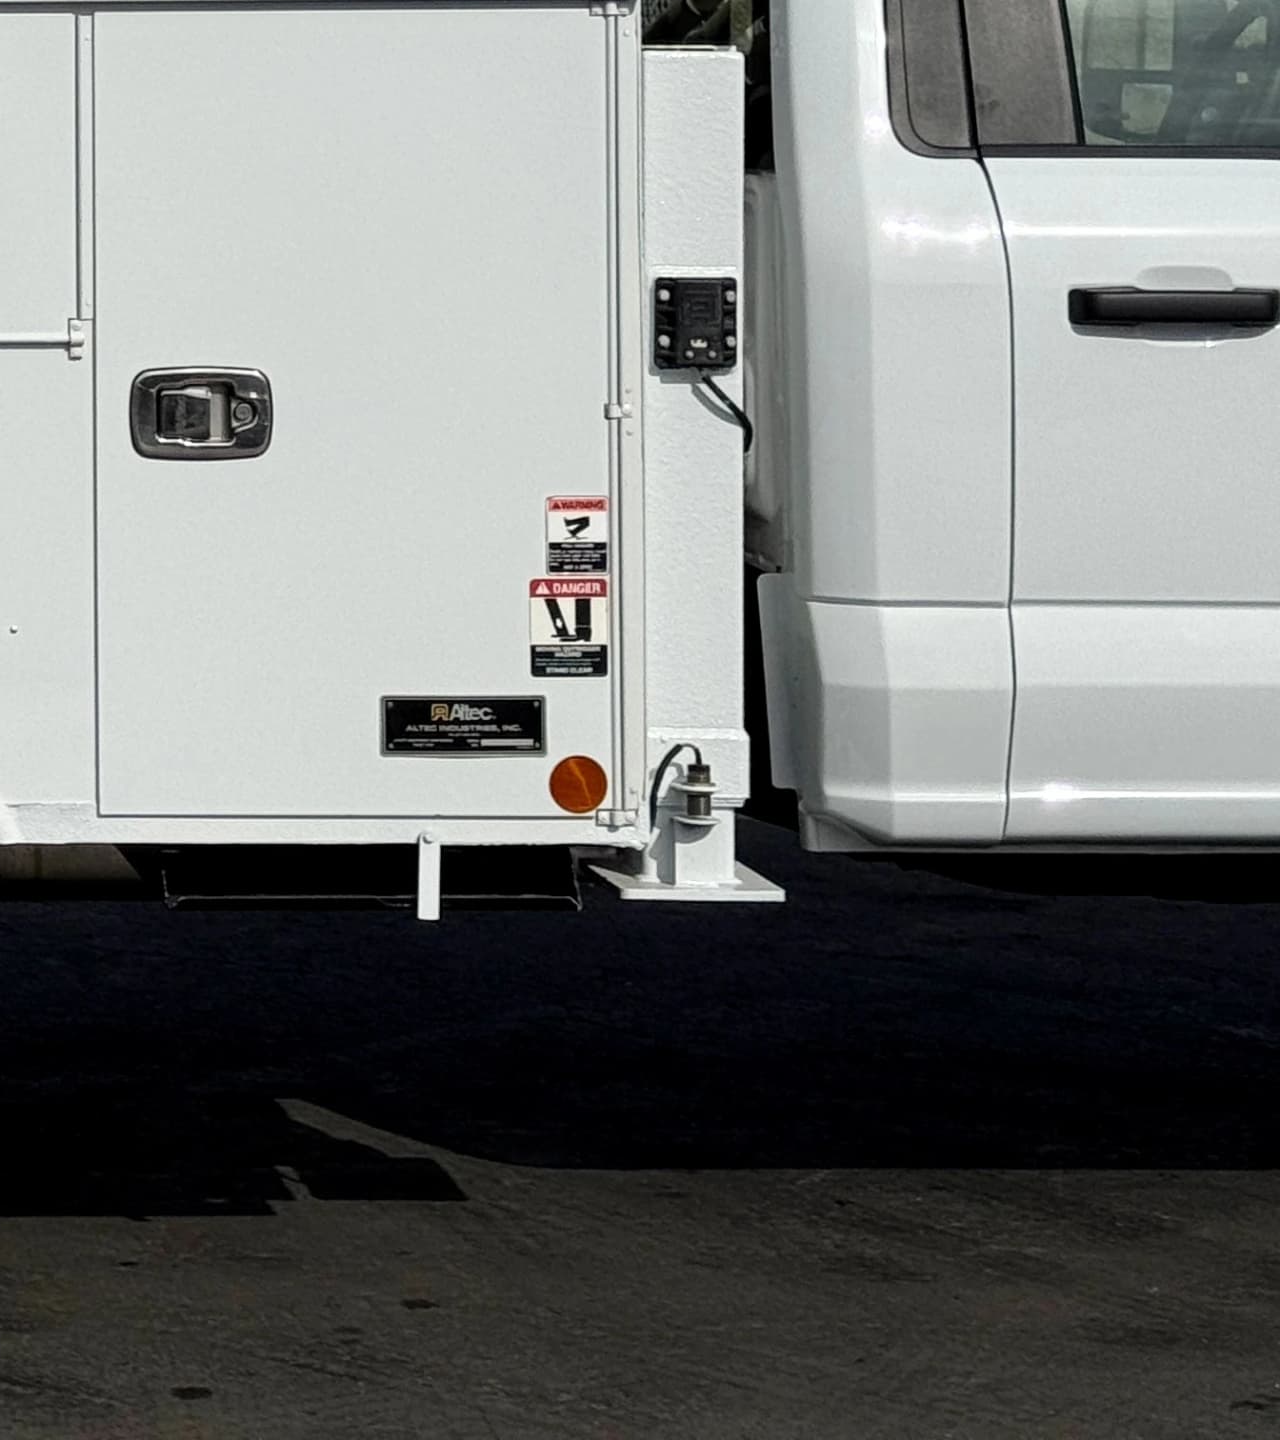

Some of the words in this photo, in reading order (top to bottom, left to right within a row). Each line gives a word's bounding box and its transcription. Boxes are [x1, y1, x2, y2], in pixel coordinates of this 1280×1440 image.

[561, 500, 604, 509] WARNING
[552, 582, 600, 594] DANGER
[450, 703, 493, 721] Altec
